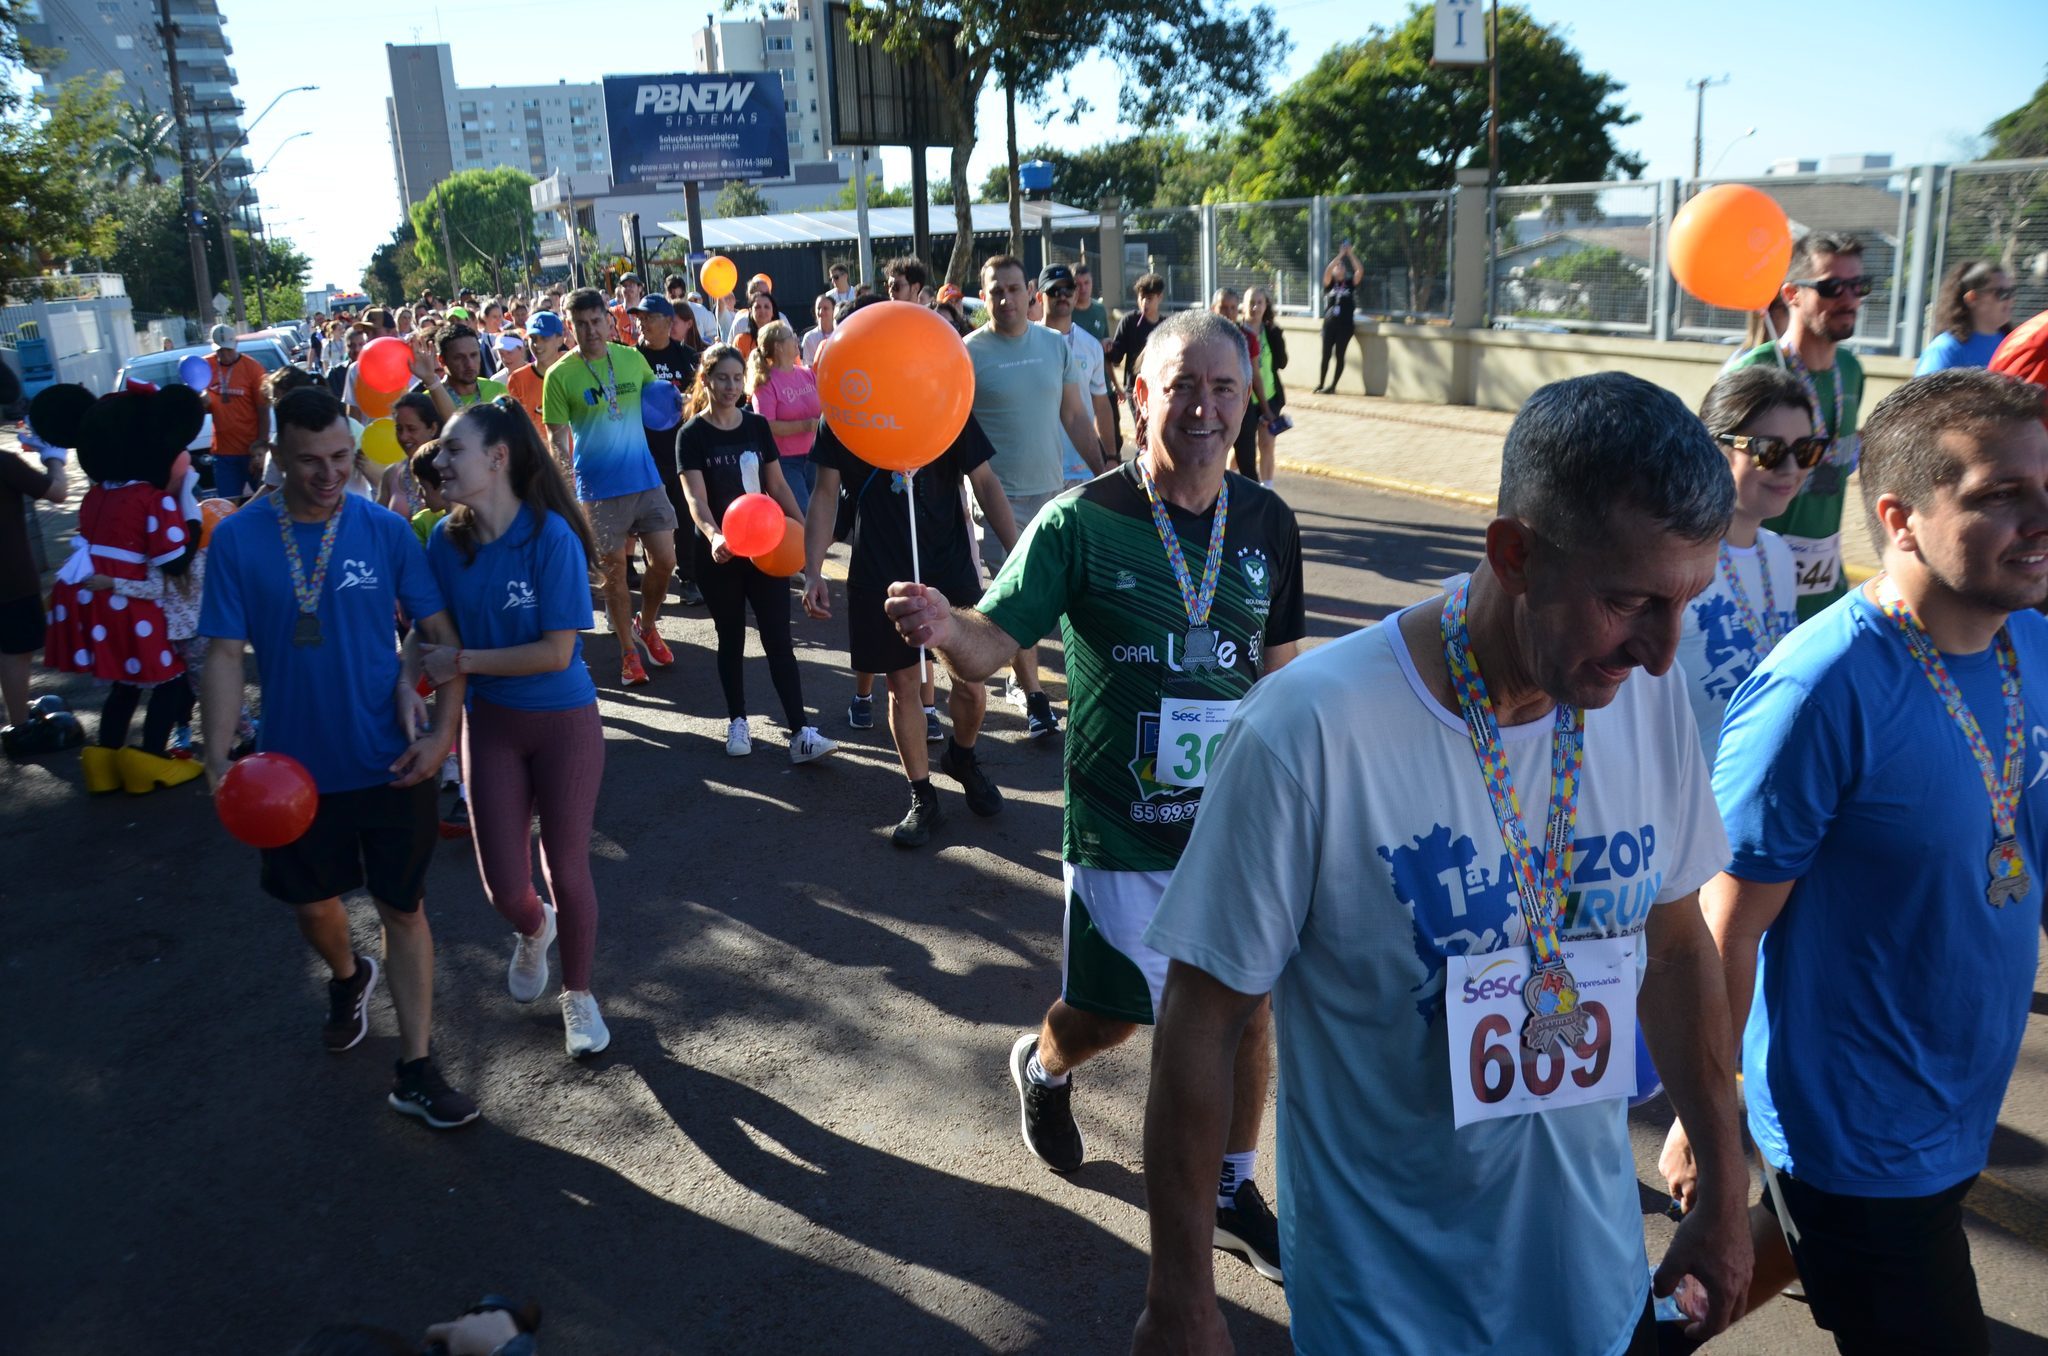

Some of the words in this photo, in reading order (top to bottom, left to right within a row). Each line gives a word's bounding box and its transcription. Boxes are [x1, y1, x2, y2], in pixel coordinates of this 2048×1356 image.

[635, 82, 755, 115] PBNEW
[665, 113, 758, 127] SISTEMAS
[659, 134, 692, 144] Soluções
[693, 132, 739, 142] tecnológicas
[672, 142, 704, 152] produtos
[1112, 645, 1159, 663] ORAL
[1131, 803, 1156, 822] 55
[1437, 864, 1486, 917] 1ª
[1575, 976, 1621, 988] mpresariais
[1470, 1000, 1612, 1104] 669
